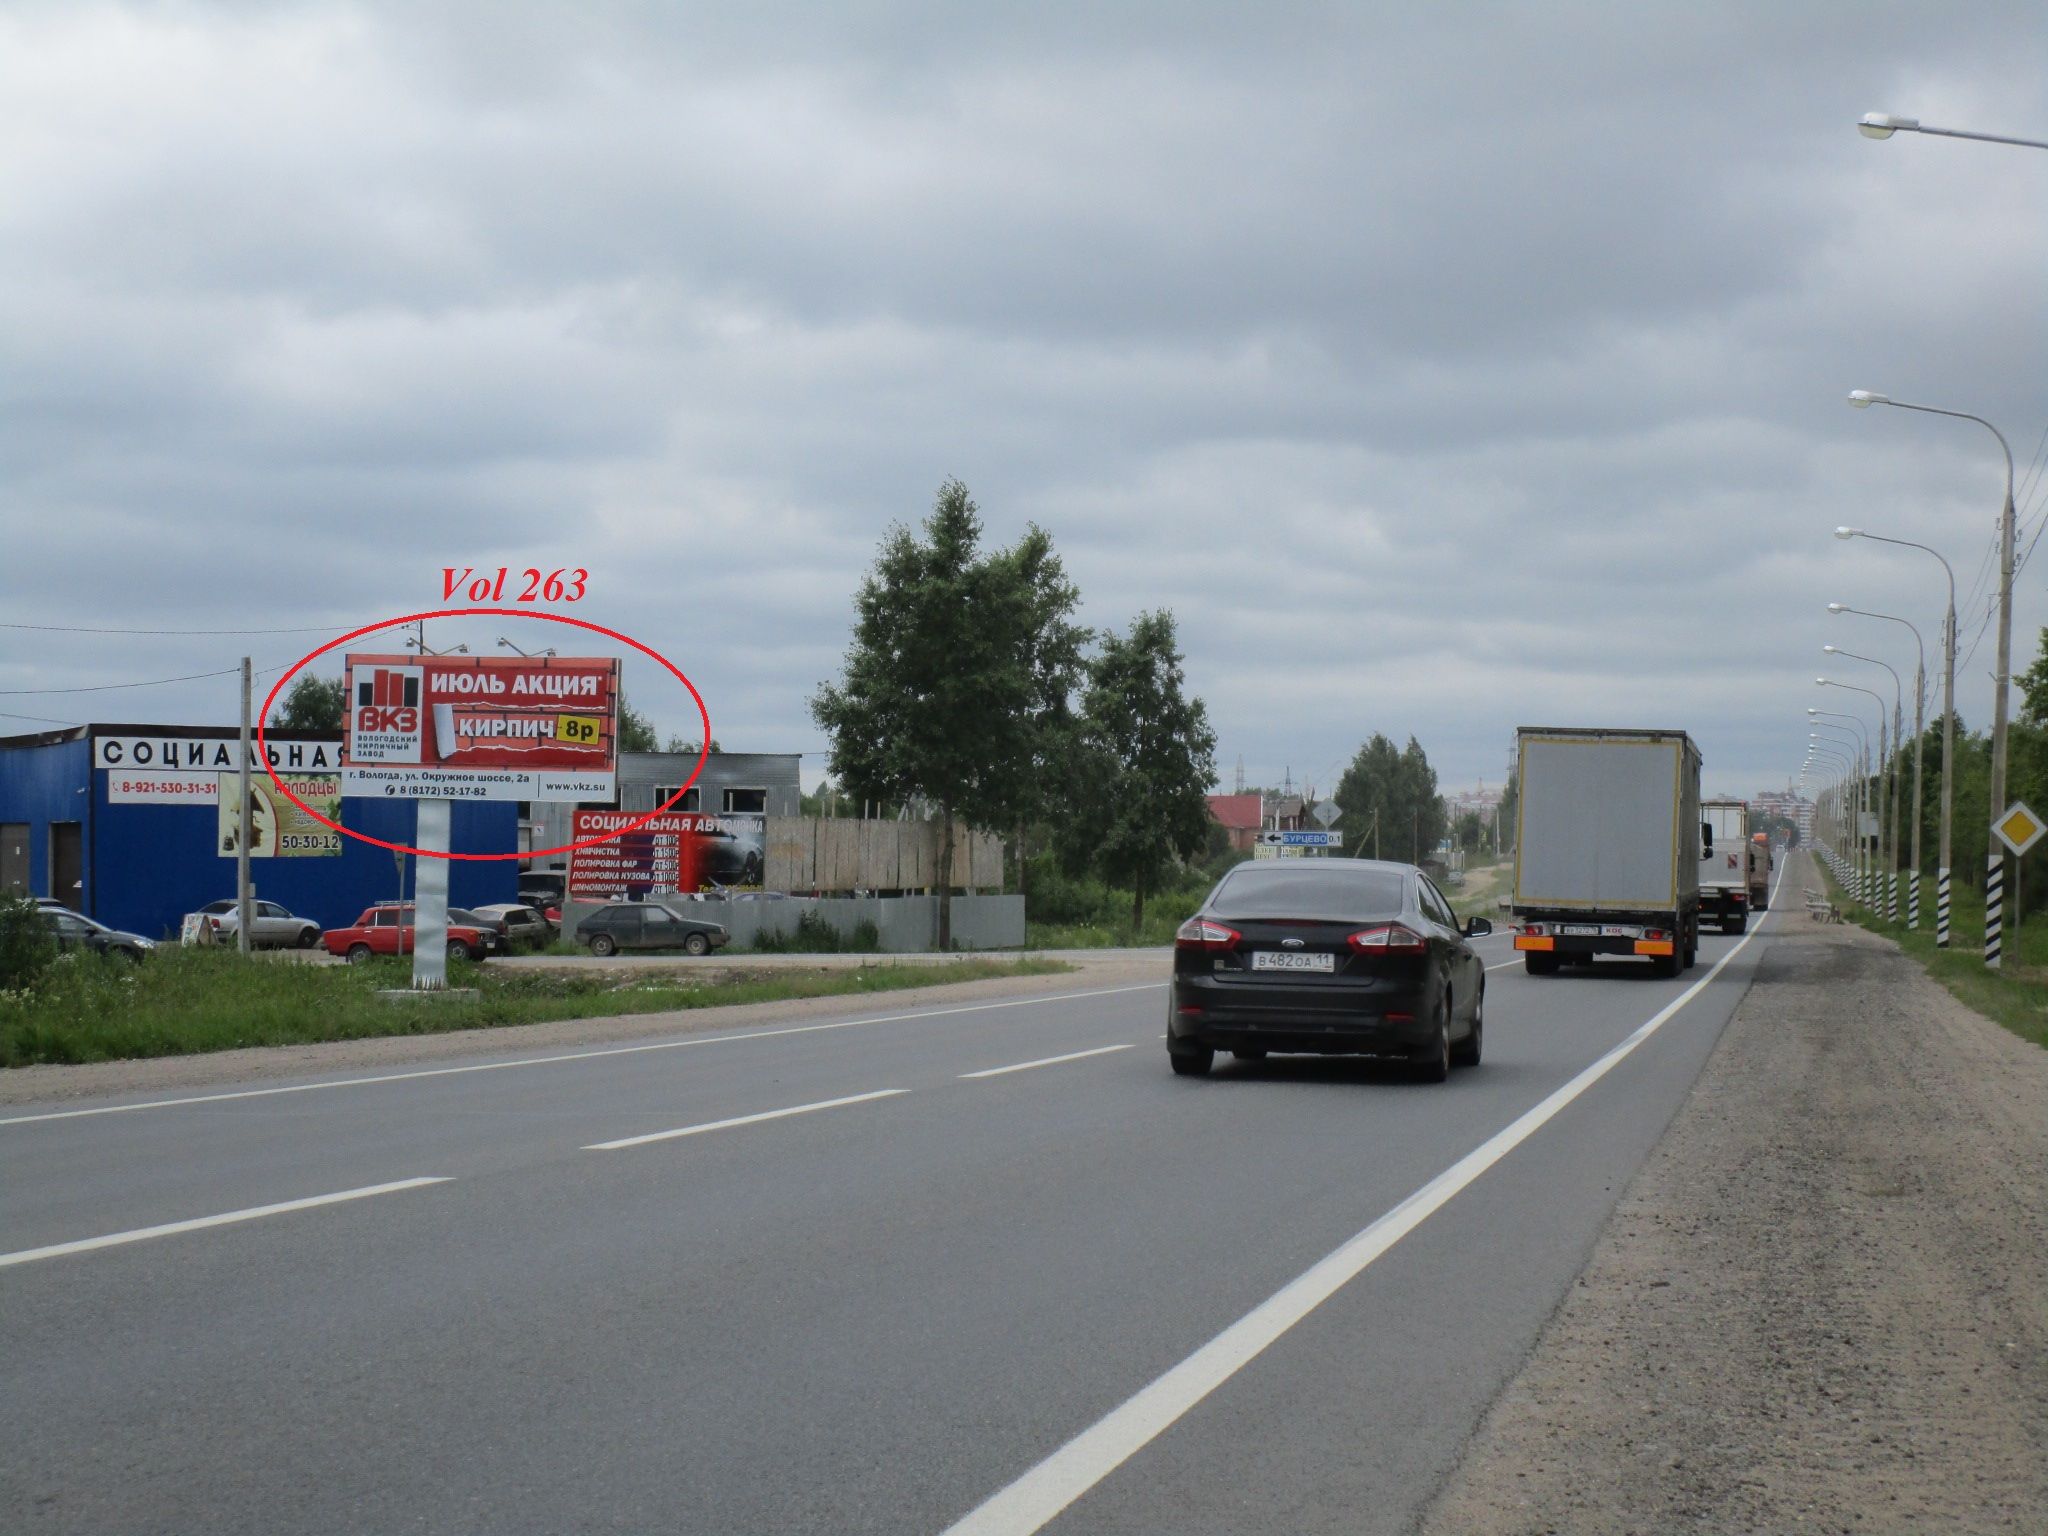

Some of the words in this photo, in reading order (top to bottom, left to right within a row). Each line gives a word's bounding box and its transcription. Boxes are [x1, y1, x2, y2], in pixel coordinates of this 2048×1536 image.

[431, 673, 506, 694] ИЮЛЬ
[358, 707, 418, 733] ВКЗ
[460, 719, 554, 739] КИРПИЧ
[565, 720, 594, 739] 8р
[358, 735, 418, 743] ВОЛОГОДСКИЙ
[358, 743, 410, 751] КИРПИЧНЫЙ
[357, 751, 385, 759] ЗАВОД
[359, 770, 403, 782] Вологда,
[405, 773, 419, 782] ул.
[421, 773, 475, 784] Окружное
[477, 774, 515, 784] шоссе,
[517, 774, 530, 784] 2а
[122, 782, 217, 794] 8-921-530-31-31
[399, 785, 407, 795] 8
[408, 785, 441, 797] (8172)
[443, 786, 487, 797] 52-17-82
[546, 782, 606, 793] www.vkz.su
[281, 835, 340, 849] 50-30-12
[1283, 835, 1327, 843] БУРЦЕВО
[574, 860, 620, 868] ПОЛИРОВКА
[572, 872, 619, 880] ПОЛИРОВКА
